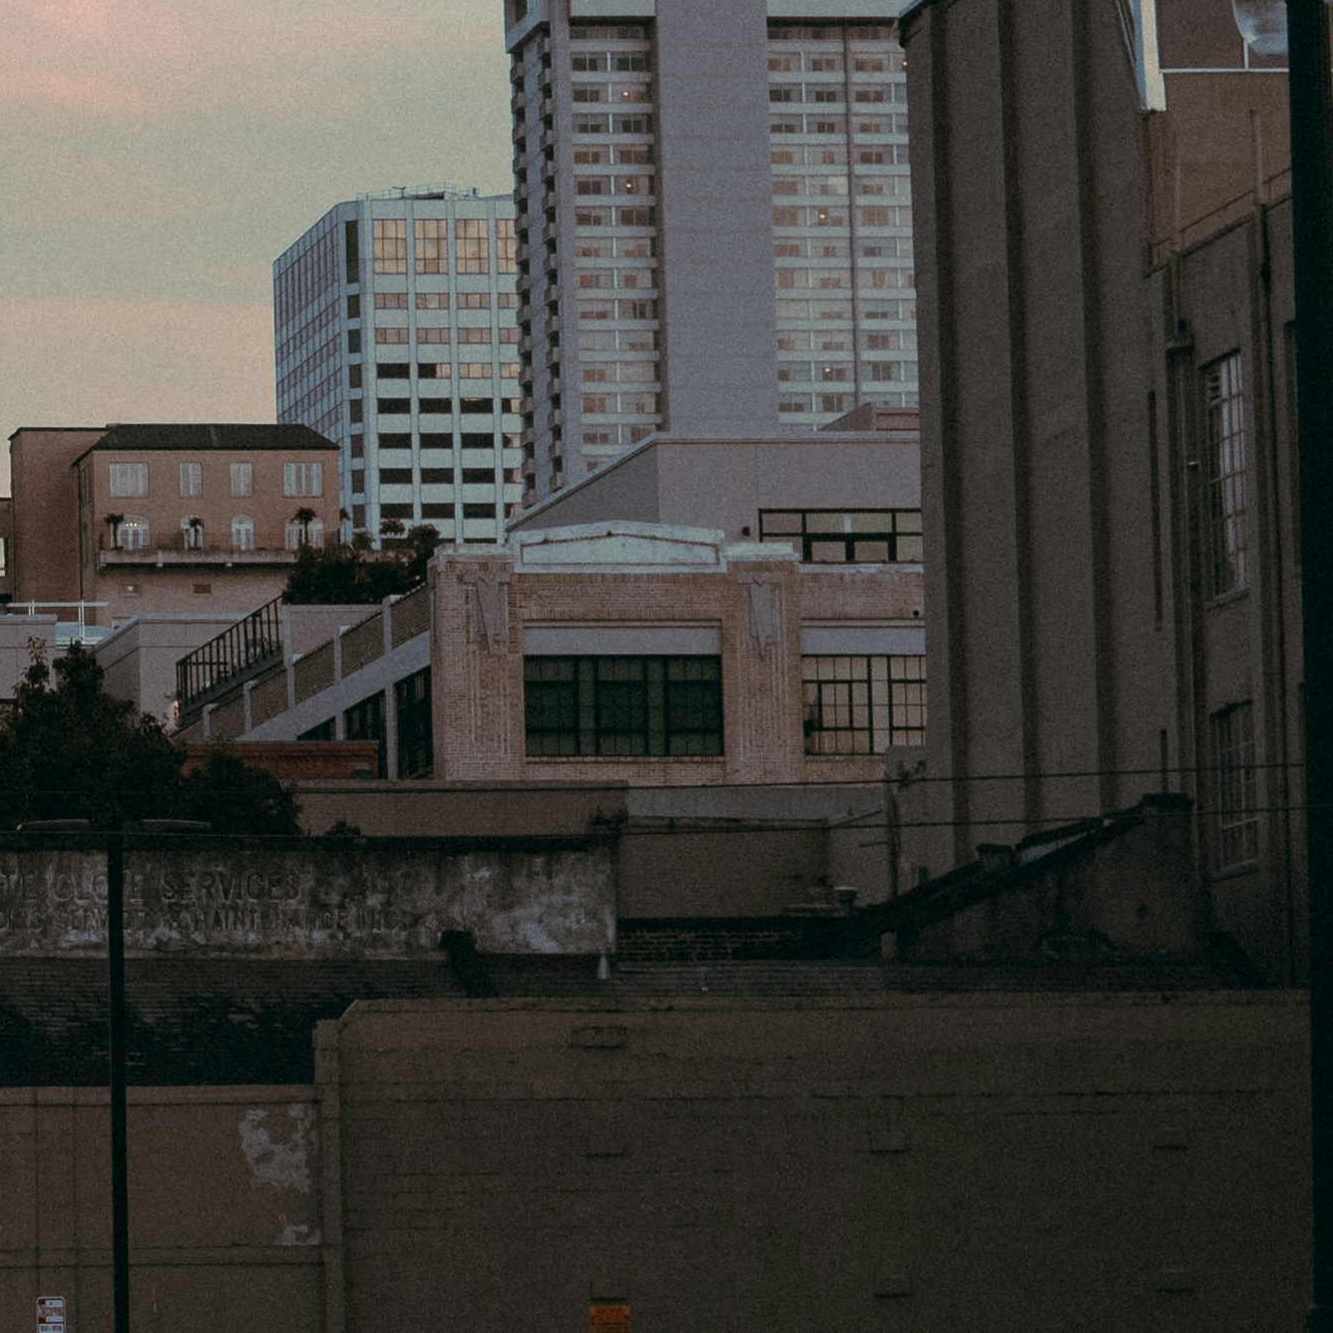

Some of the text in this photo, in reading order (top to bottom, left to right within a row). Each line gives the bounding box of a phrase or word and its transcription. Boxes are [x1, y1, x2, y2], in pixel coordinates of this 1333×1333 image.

[53, 870, 144, 903] GLOE
[160, 869, 301, 902] SERVICES
[51, 907, 157, 932] SERVIES
